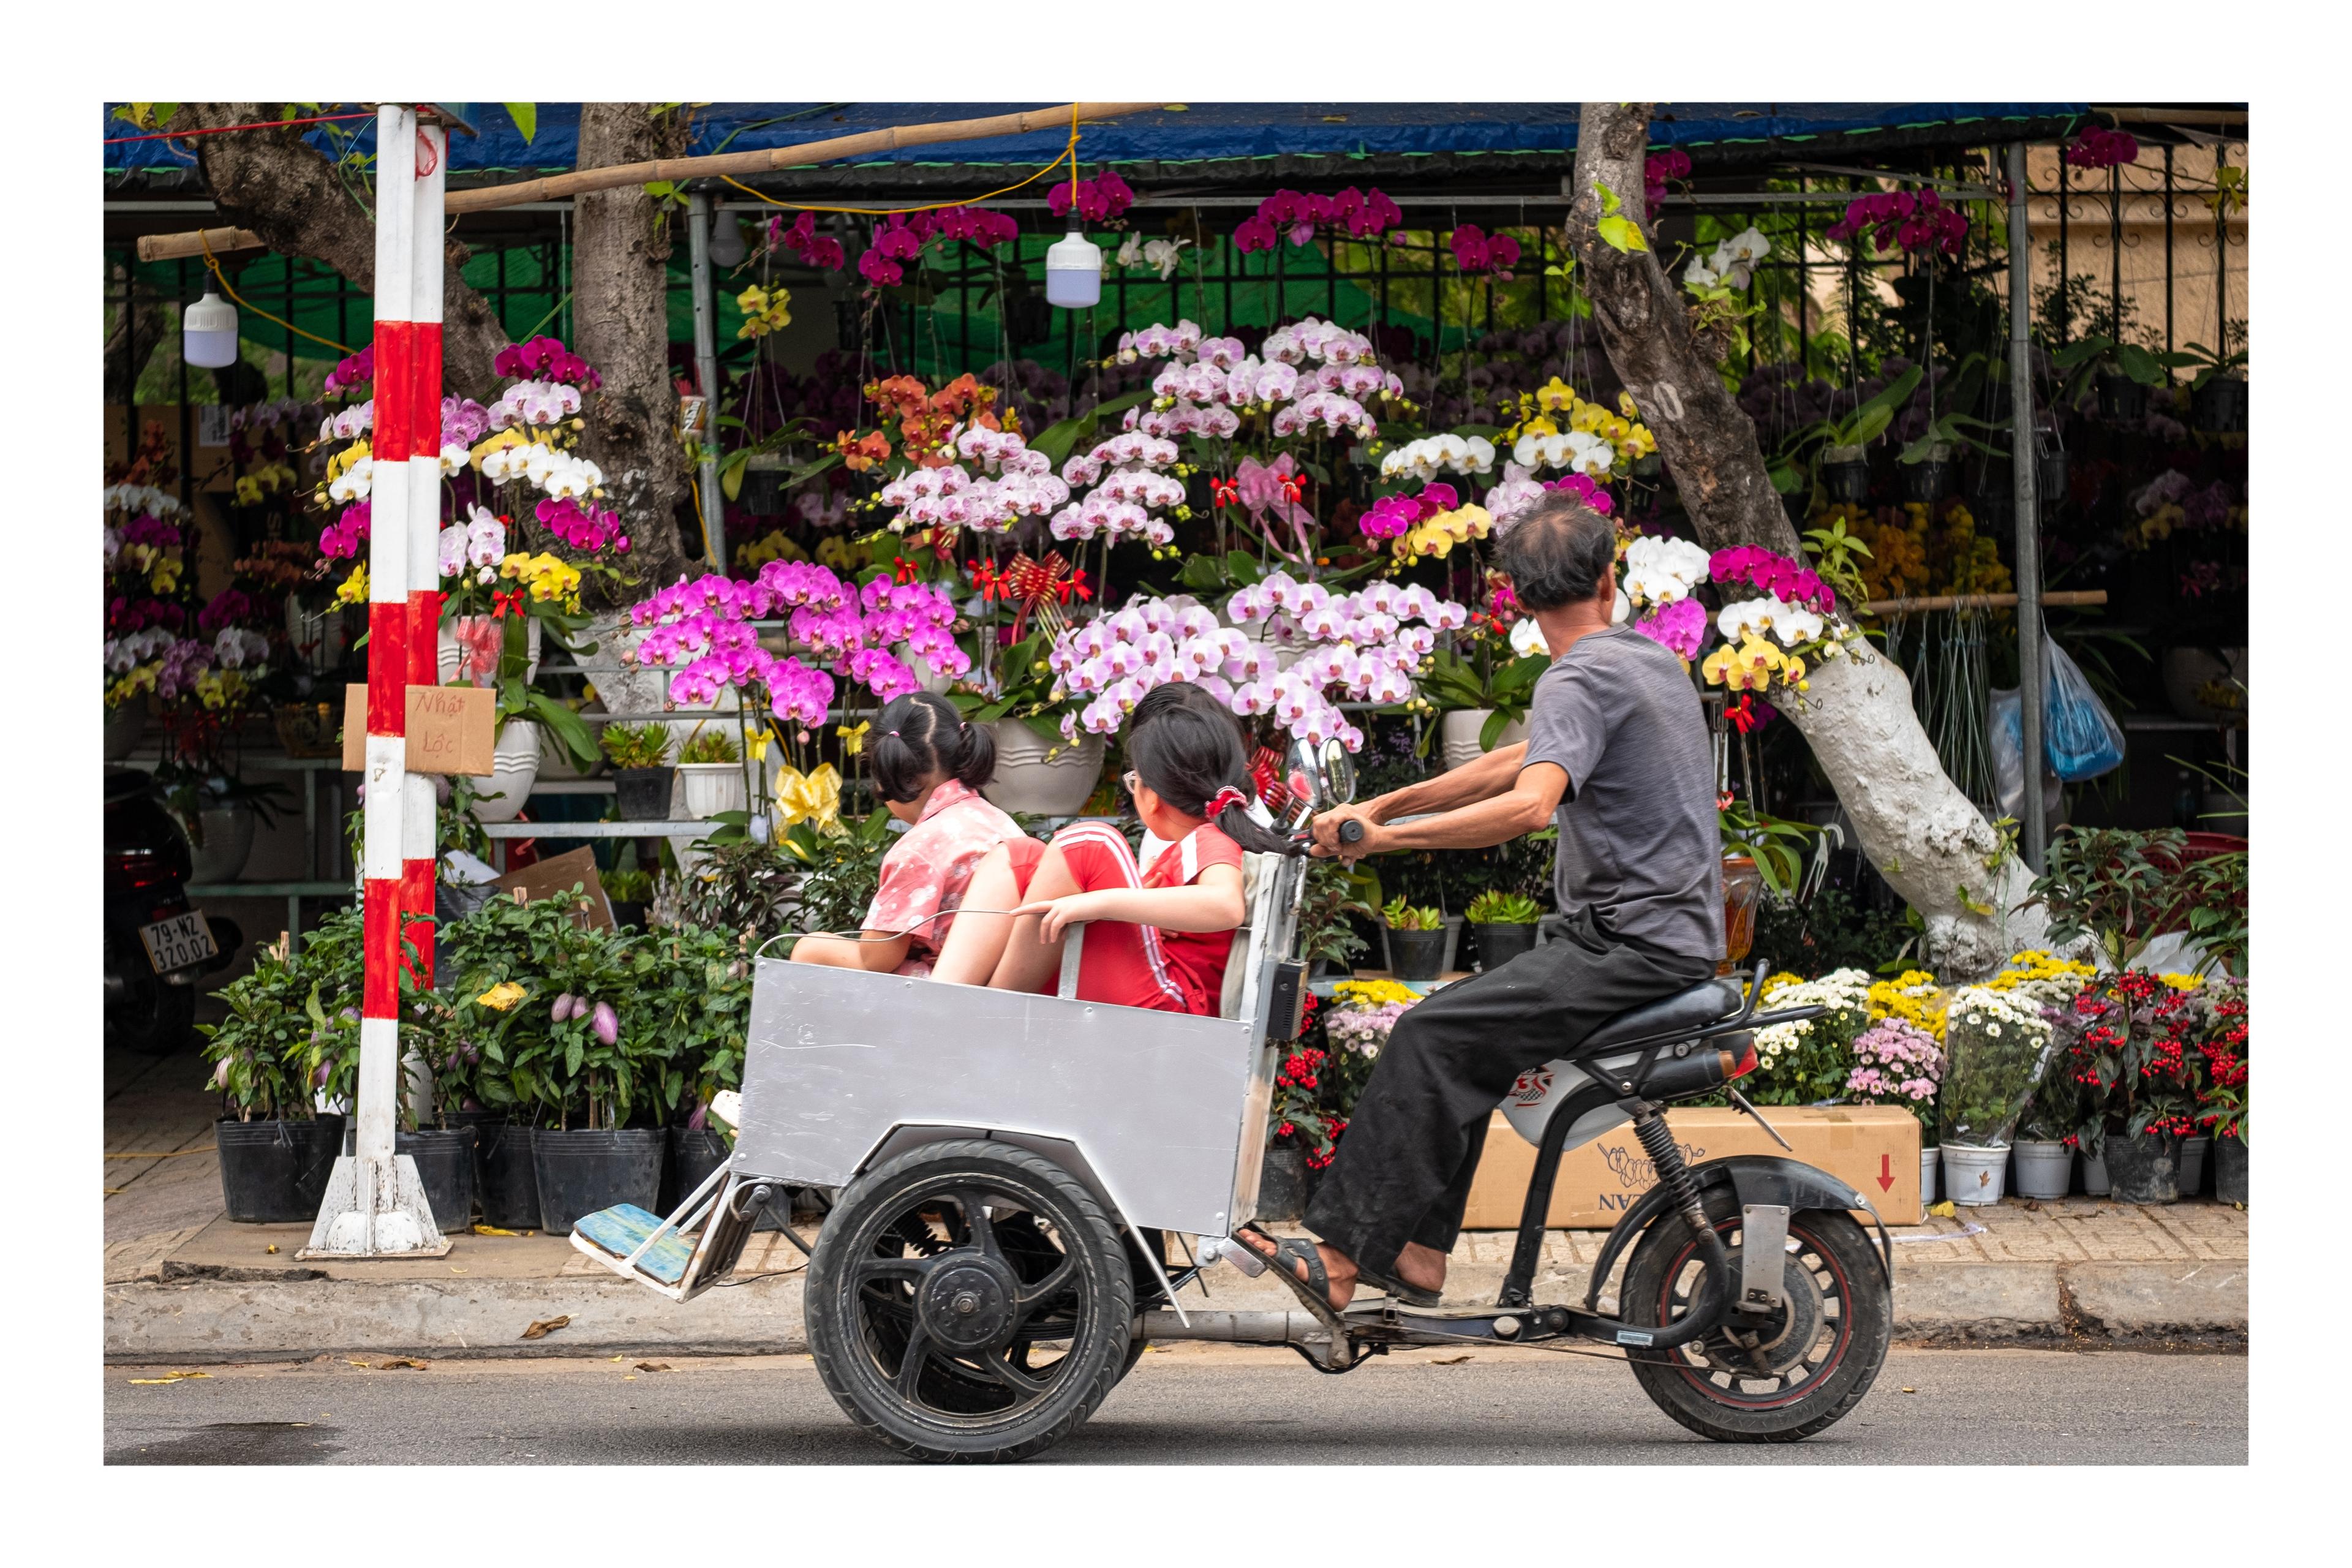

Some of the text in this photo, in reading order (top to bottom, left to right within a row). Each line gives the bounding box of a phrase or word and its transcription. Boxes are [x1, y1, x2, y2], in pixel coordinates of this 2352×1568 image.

[415, 692, 466, 717] Nhật
[423, 731, 453, 758] Lộc
[154, 935, 214, 970] 320.02
